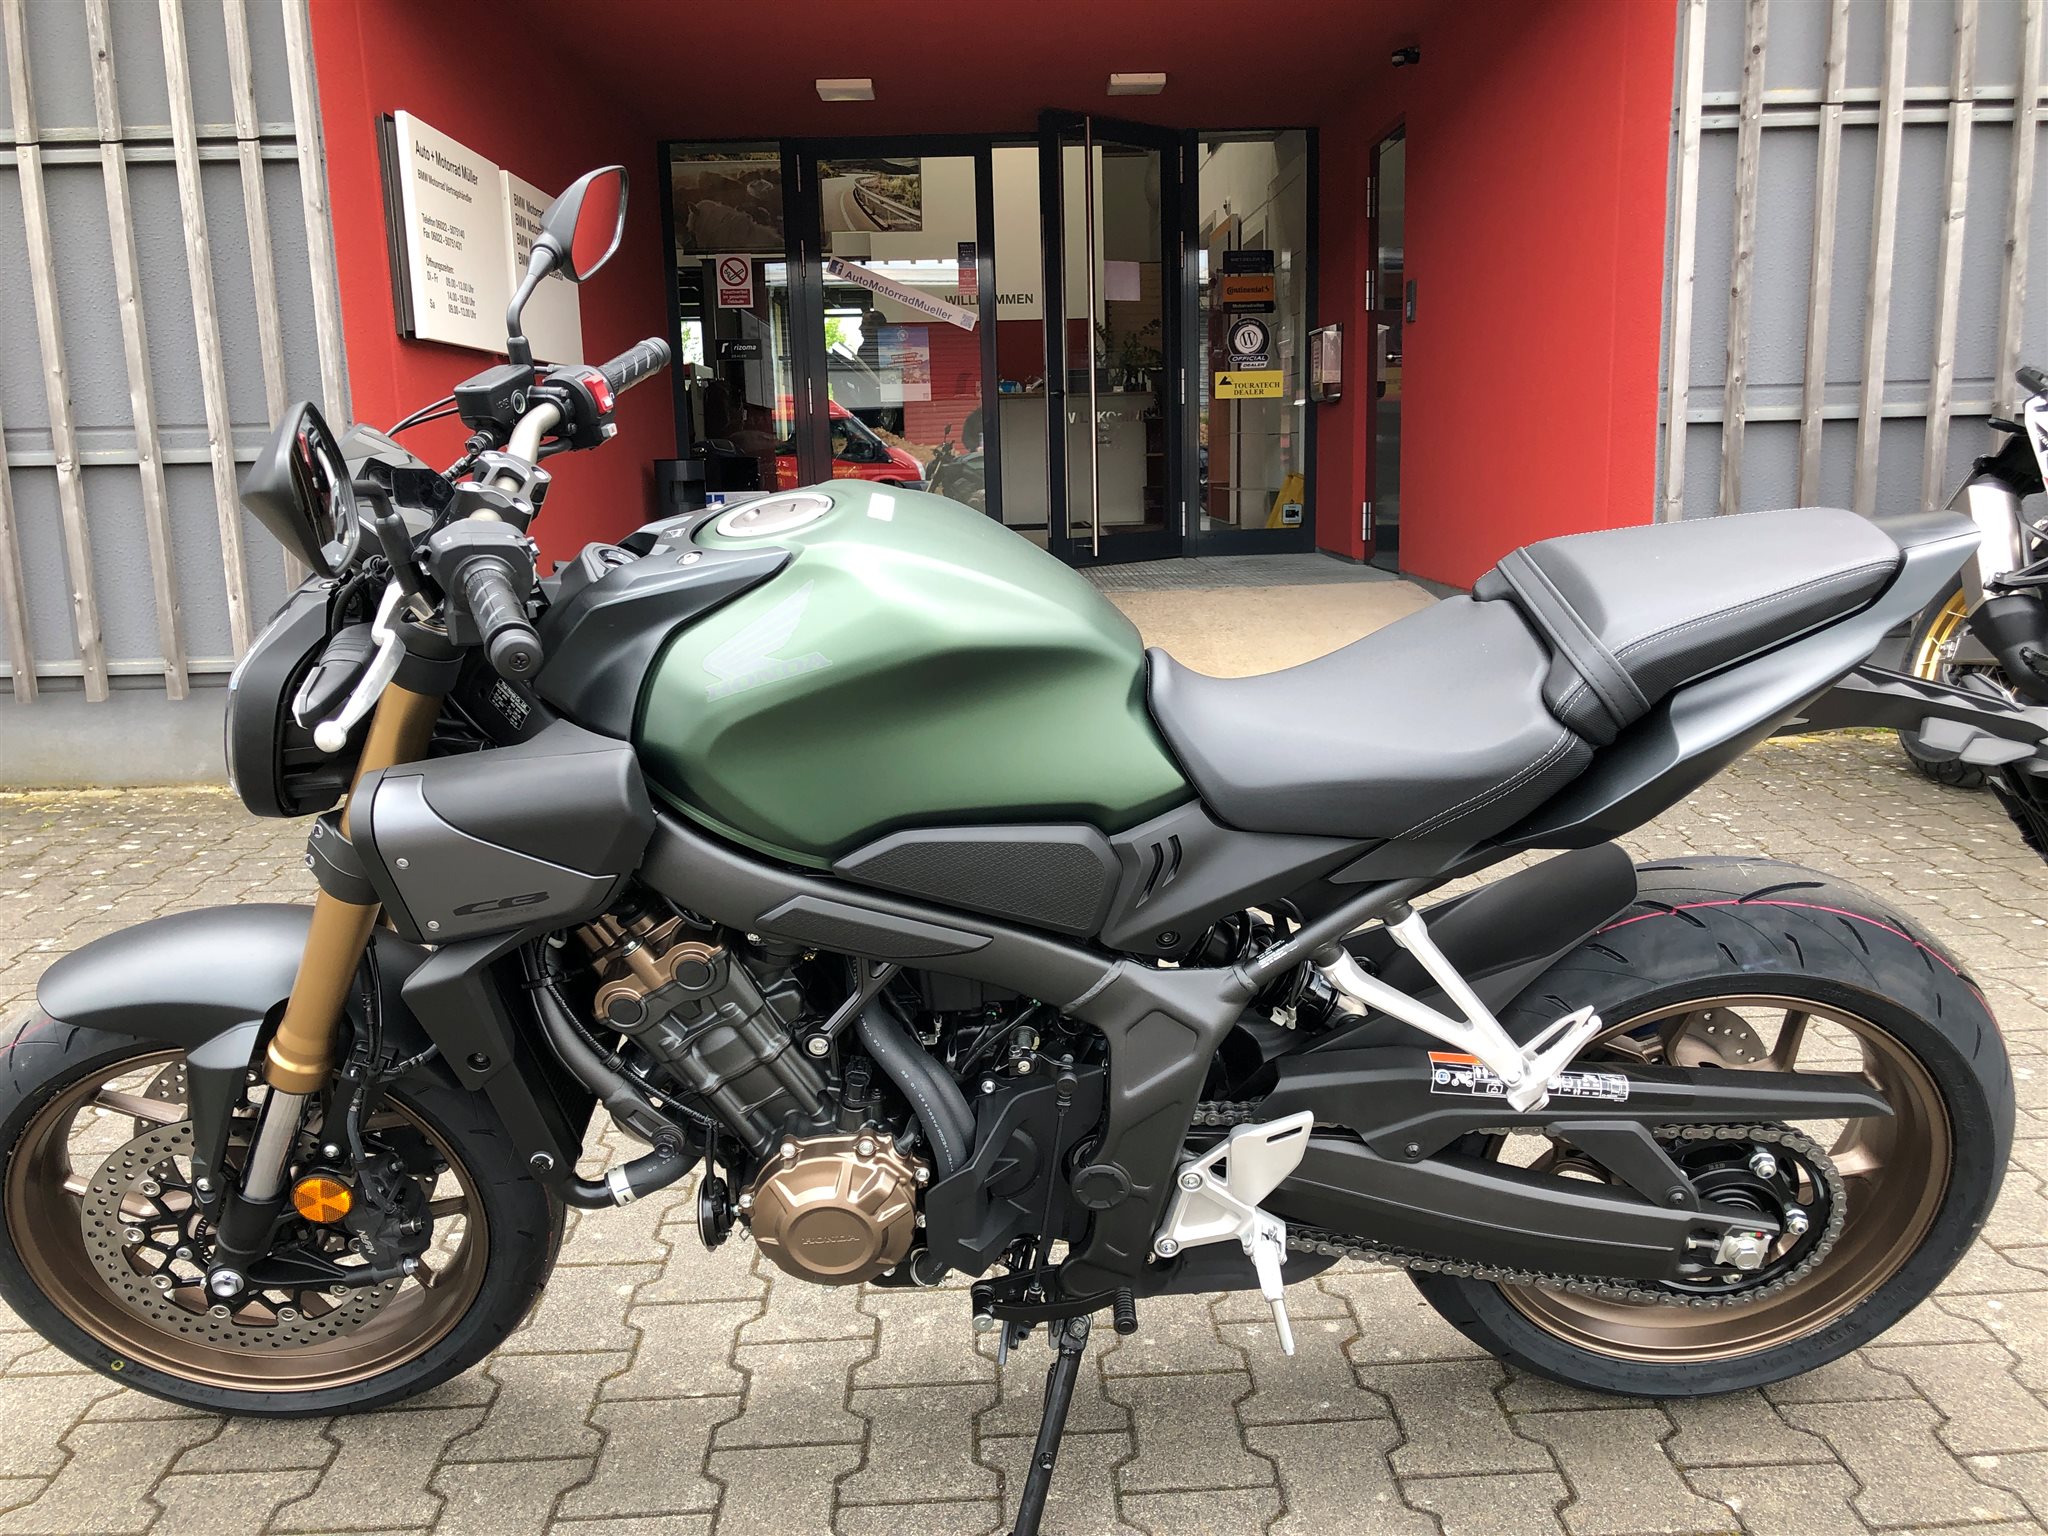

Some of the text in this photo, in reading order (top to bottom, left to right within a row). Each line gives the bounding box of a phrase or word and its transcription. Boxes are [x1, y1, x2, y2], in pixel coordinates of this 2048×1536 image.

[415, 139, 430, 161] Auto
[435, 150, 461, 177] Motorrad
[461, 164, 478, 185] Müller
[513, 193, 525, 210] BMW
[515, 212, 527, 230] BMW
[516, 232, 528, 249] BMW
[844, 269, 953, 321] AutoMotorradMueller
[1226, 286, 1264, 295] Continental
[1233, 388, 1265, 396] DEALER
[1234, 381, 1280, 389] TOURATECH
